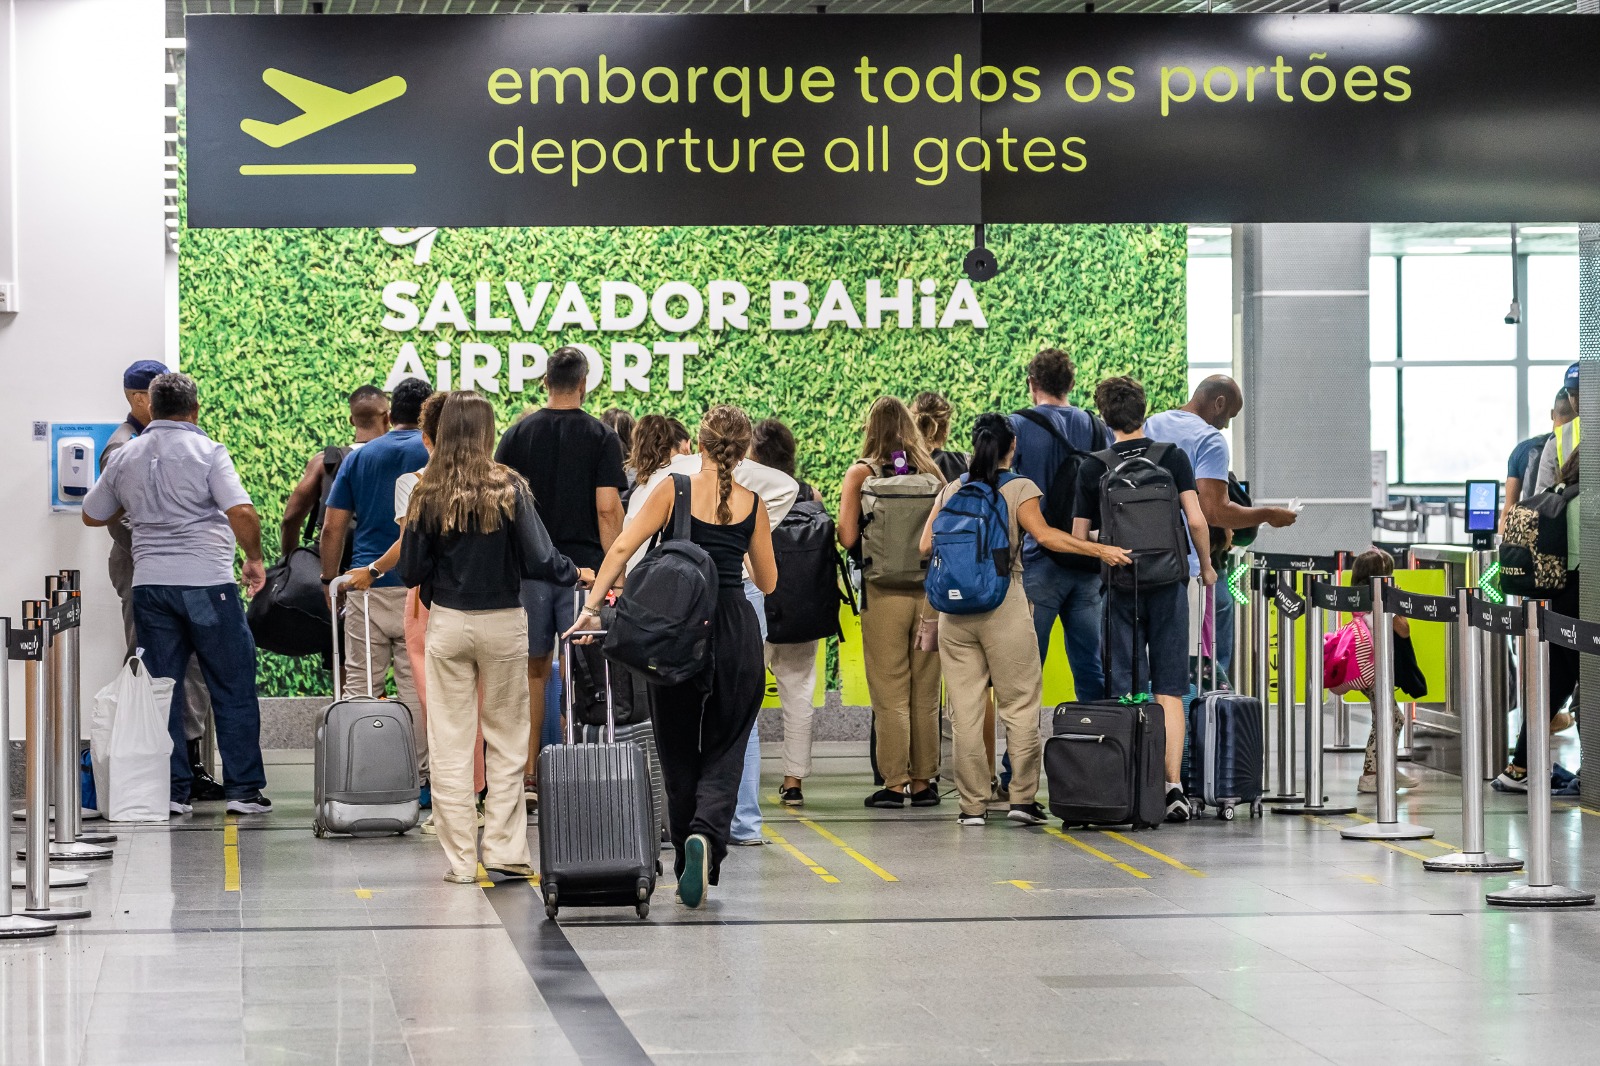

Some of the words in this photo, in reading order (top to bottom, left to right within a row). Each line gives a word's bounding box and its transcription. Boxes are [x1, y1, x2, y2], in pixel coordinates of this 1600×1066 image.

[487, 54, 836, 118] embarque
[853, 53, 1041, 104] todos
[1065, 65, 1136, 103] os
[1160, 52, 1412, 117] portões
[488, 125, 806, 187] departure
[824, 124, 889, 173] all
[913, 127, 1088, 187] gates
[380, 278, 751, 332] SALVADOR
[1276, 588, 1294, 608] VINCI
